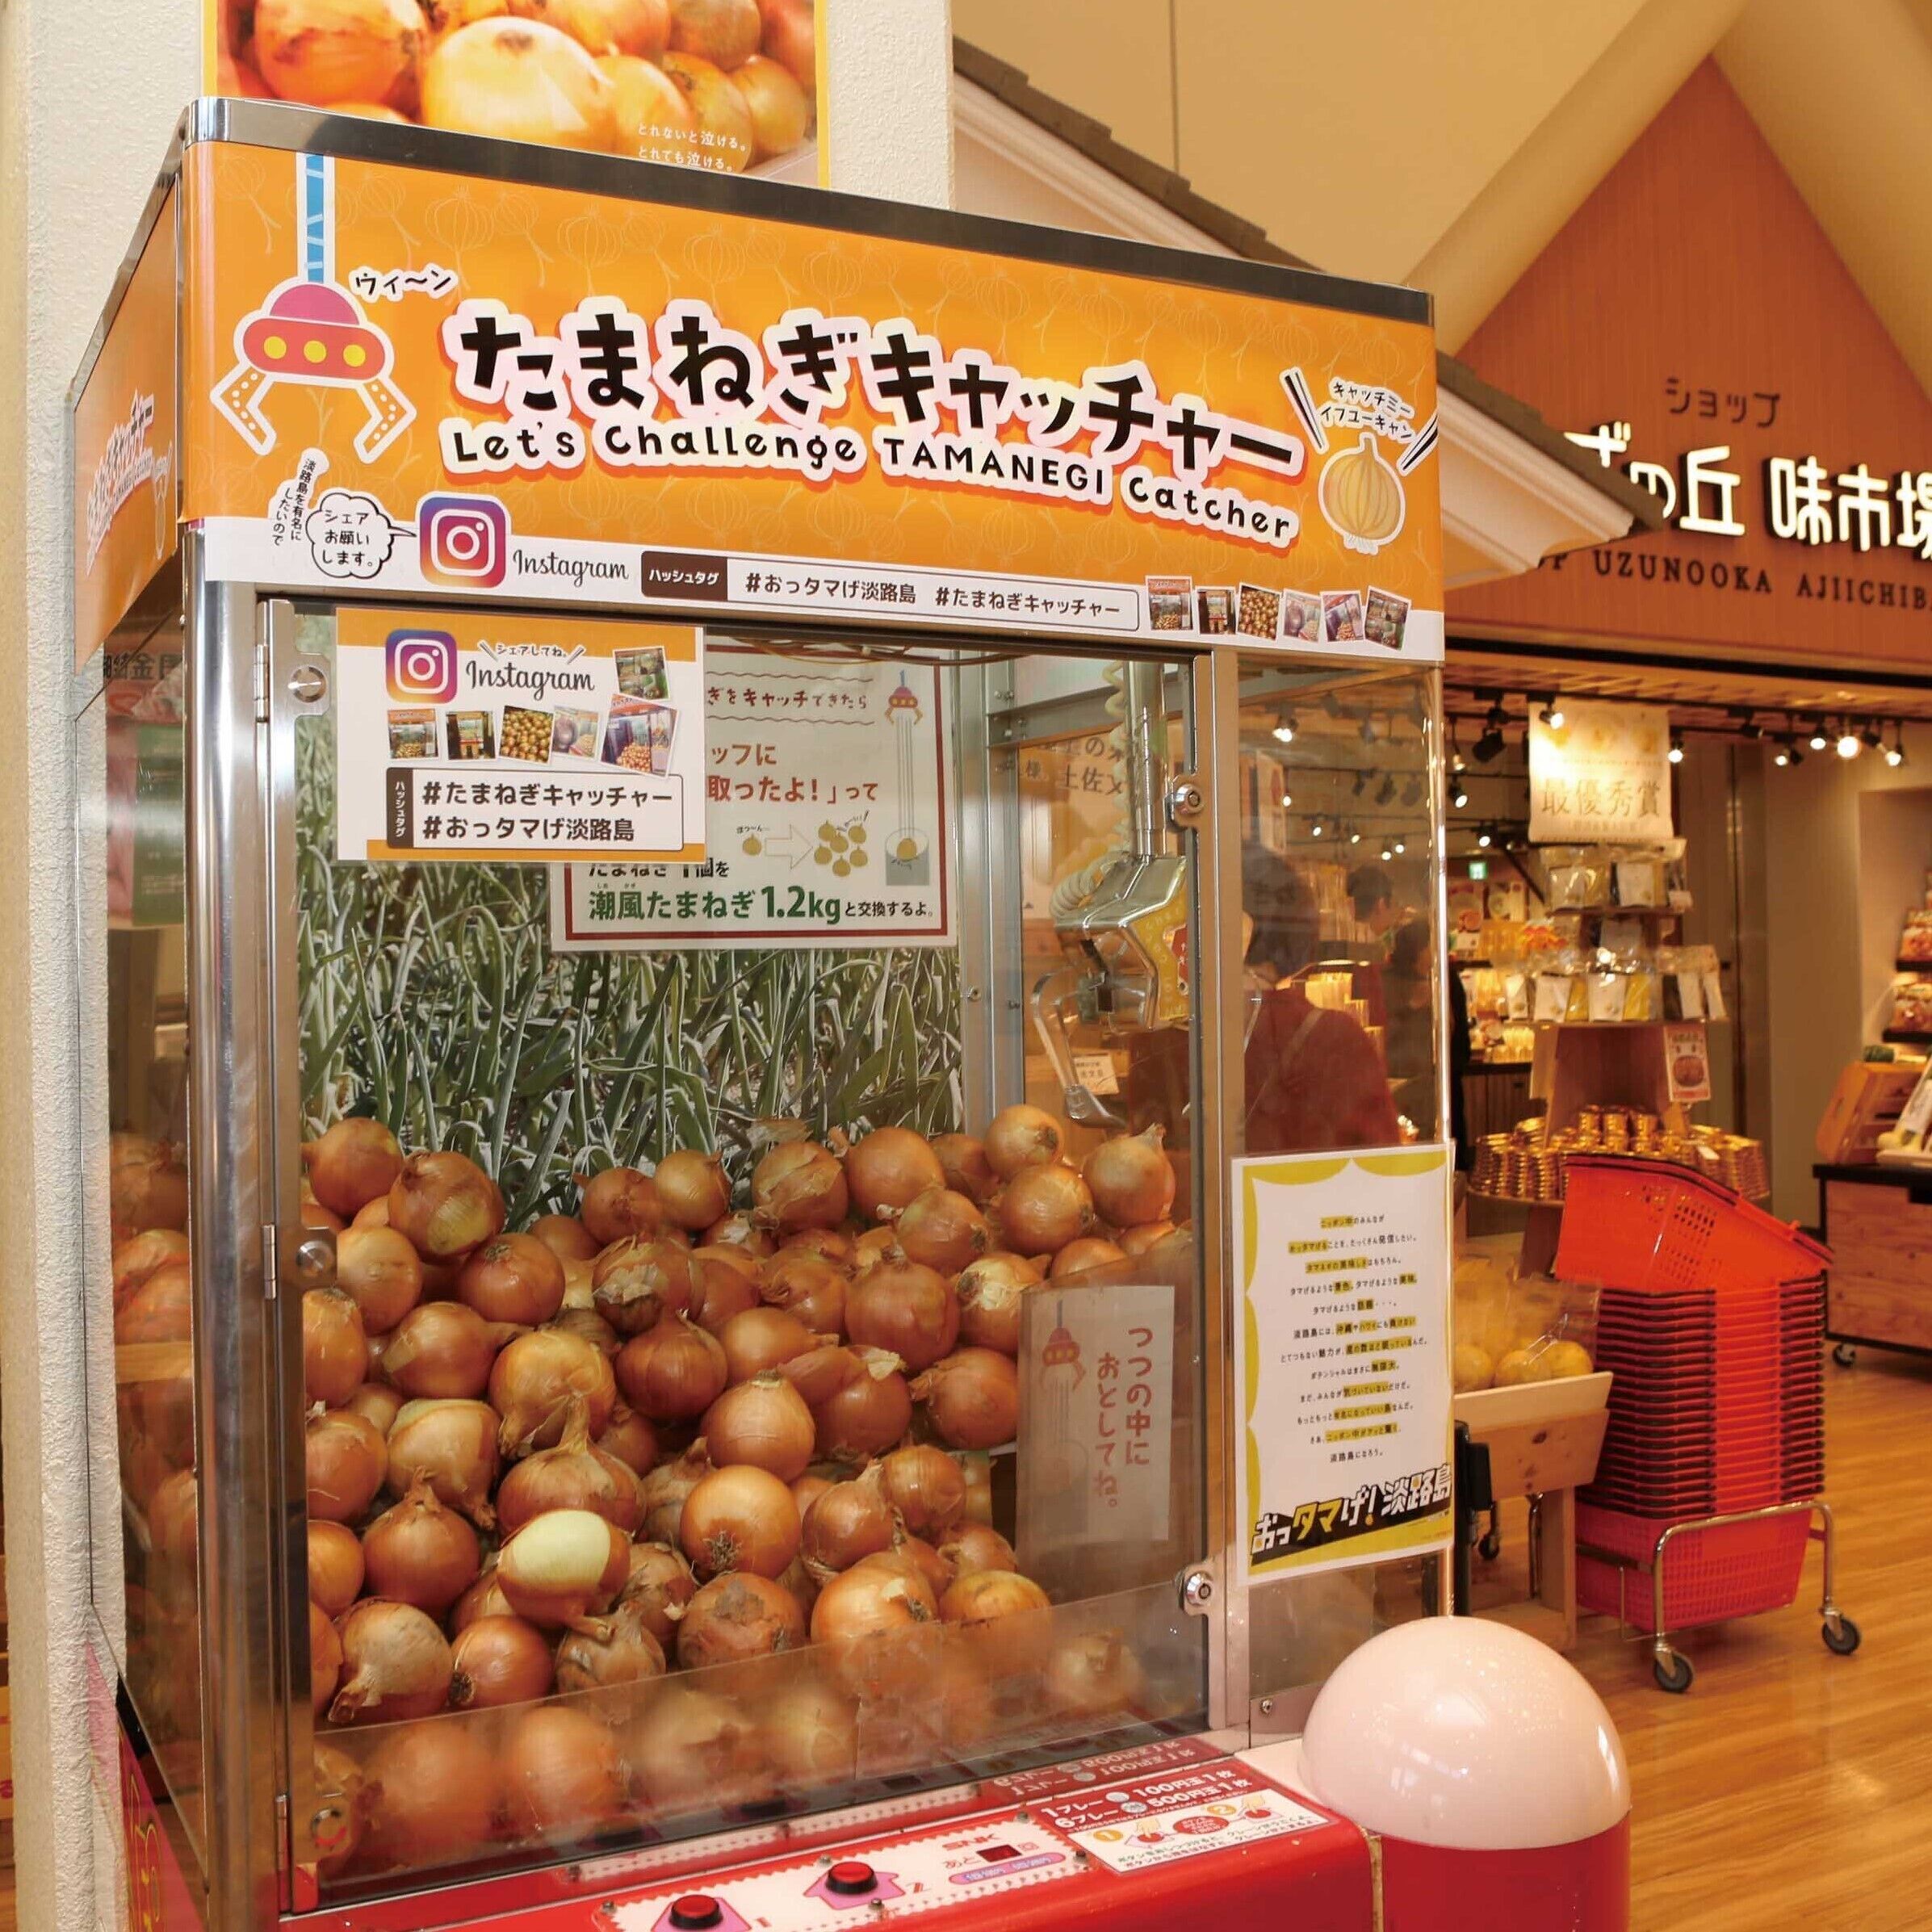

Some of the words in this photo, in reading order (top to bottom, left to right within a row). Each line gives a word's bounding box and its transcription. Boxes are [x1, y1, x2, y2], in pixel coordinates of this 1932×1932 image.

[638, 122, 746, 152] とれないと泣ける。
[638, 145, 733, 172] とれても泣ける。
[460, 312, 1292, 470] たまねぎキャッチャー
[1333, 380, 1411, 413] キャッチミー
[1665, 376, 1780, 427] ショップ
[1321, 406, 1412, 439] イフユーキャン
[290, 458, 317, 542] 淡路島を有名に
[453, 421, 576, 463] Let's
[605, 425, 857, 469] Challenge
[883, 437, 1104, 495] TAMANEGI
[1128, 475, 1290, 539] Catcher
[272, 488, 295, 547] したいので
[324, 509, 369, 526] シェア
[324, 529, 370, 546] お願い
[322, 550, 373, 567] します。
[512, 548, 629, 588] Instagram
[647, 568, 719, 586] ハッシュタグ
[745, 572, 916, 604] #おっタマげ淡路島
[934, 588, 1120, 615] #たまねぎキャッチャー
[1593, 549, 1773, 593] UZUNOOKA
[1796, 572, 1932, 610] AJIICHIB
[465, 660, 596, 702] Instagram
[711, 743, 777, 766] ッフに
[395, 781, 406, 838] ハッシュタグ
[421, 781, 673, 807] #たまねぎキャッチャー
[422, 816, 635, 842] #おっタマげ淡路島
[1125, 1326, 1154, 1466] つつの中に
[1095, 1352, 1120, 1508] おとしてね。
